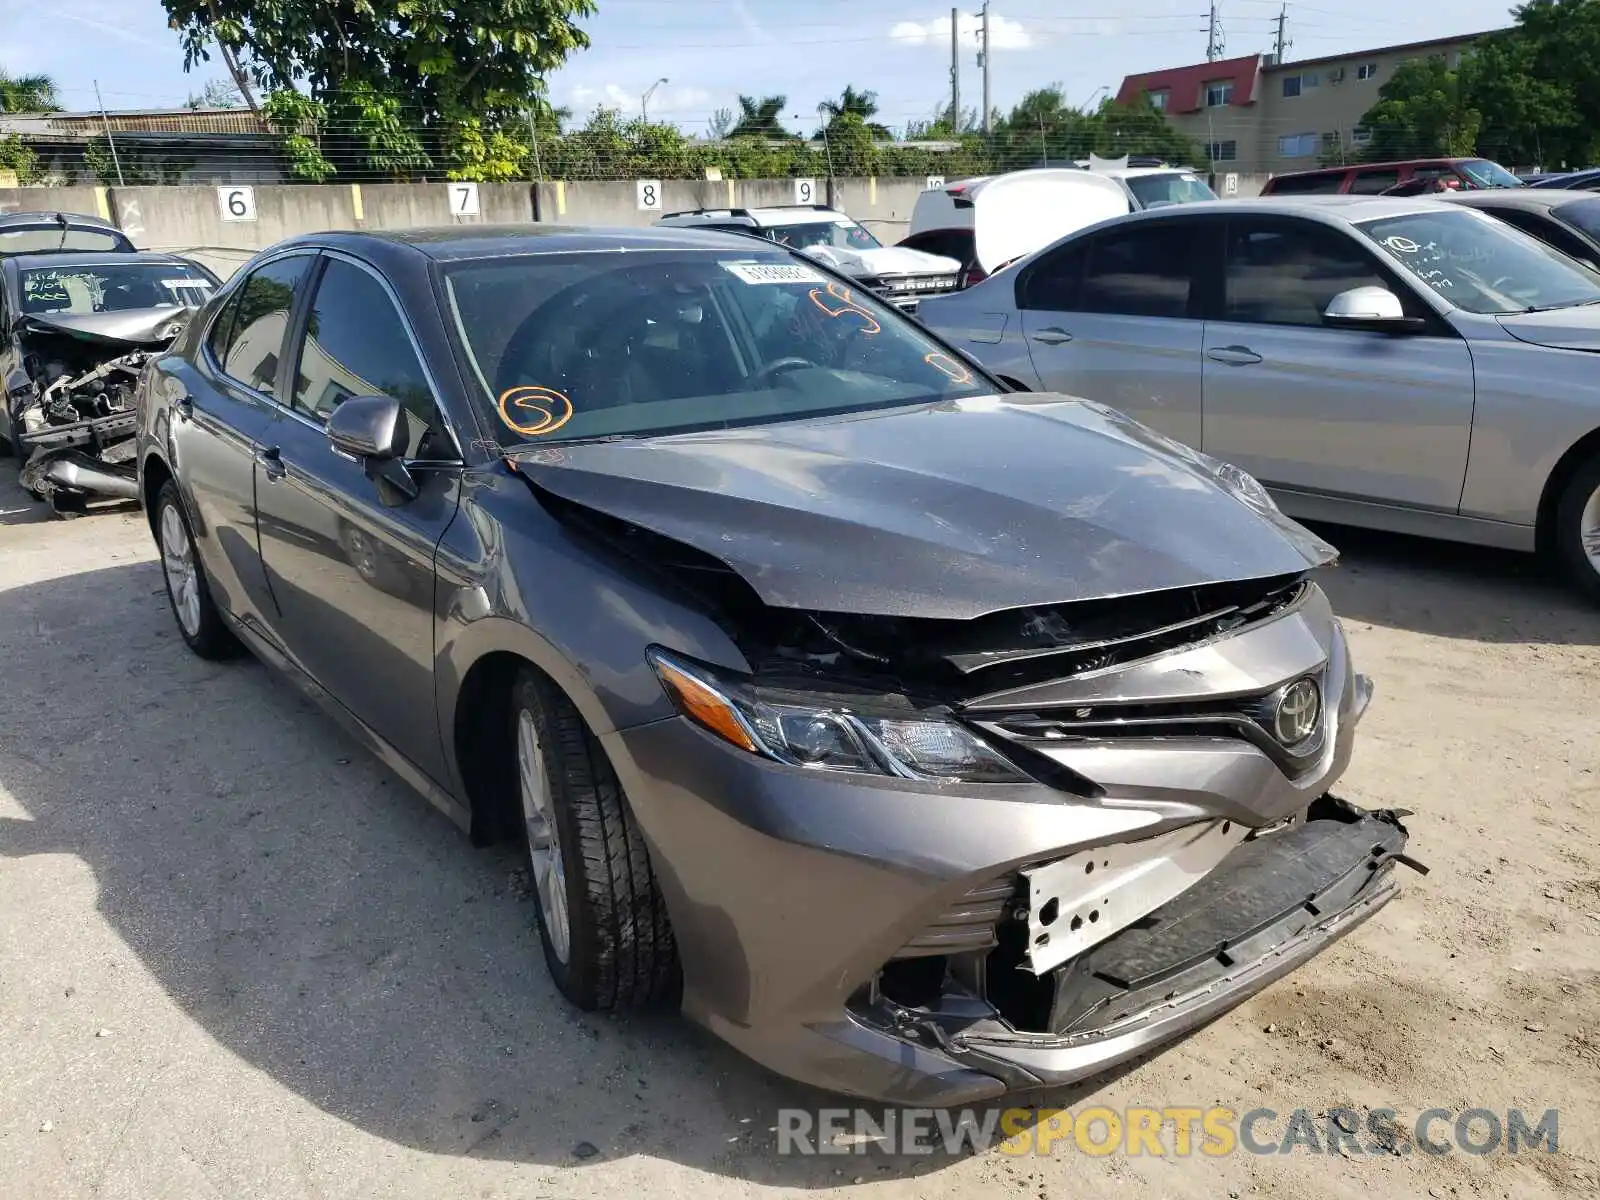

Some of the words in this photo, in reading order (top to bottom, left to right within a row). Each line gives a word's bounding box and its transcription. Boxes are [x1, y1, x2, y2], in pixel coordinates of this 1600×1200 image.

[228, 190, 247, 217] 6
[456, 187, 470, 211] 7
[643, 184, 656, 206] 8
[800, 182, 811, 202] 9
